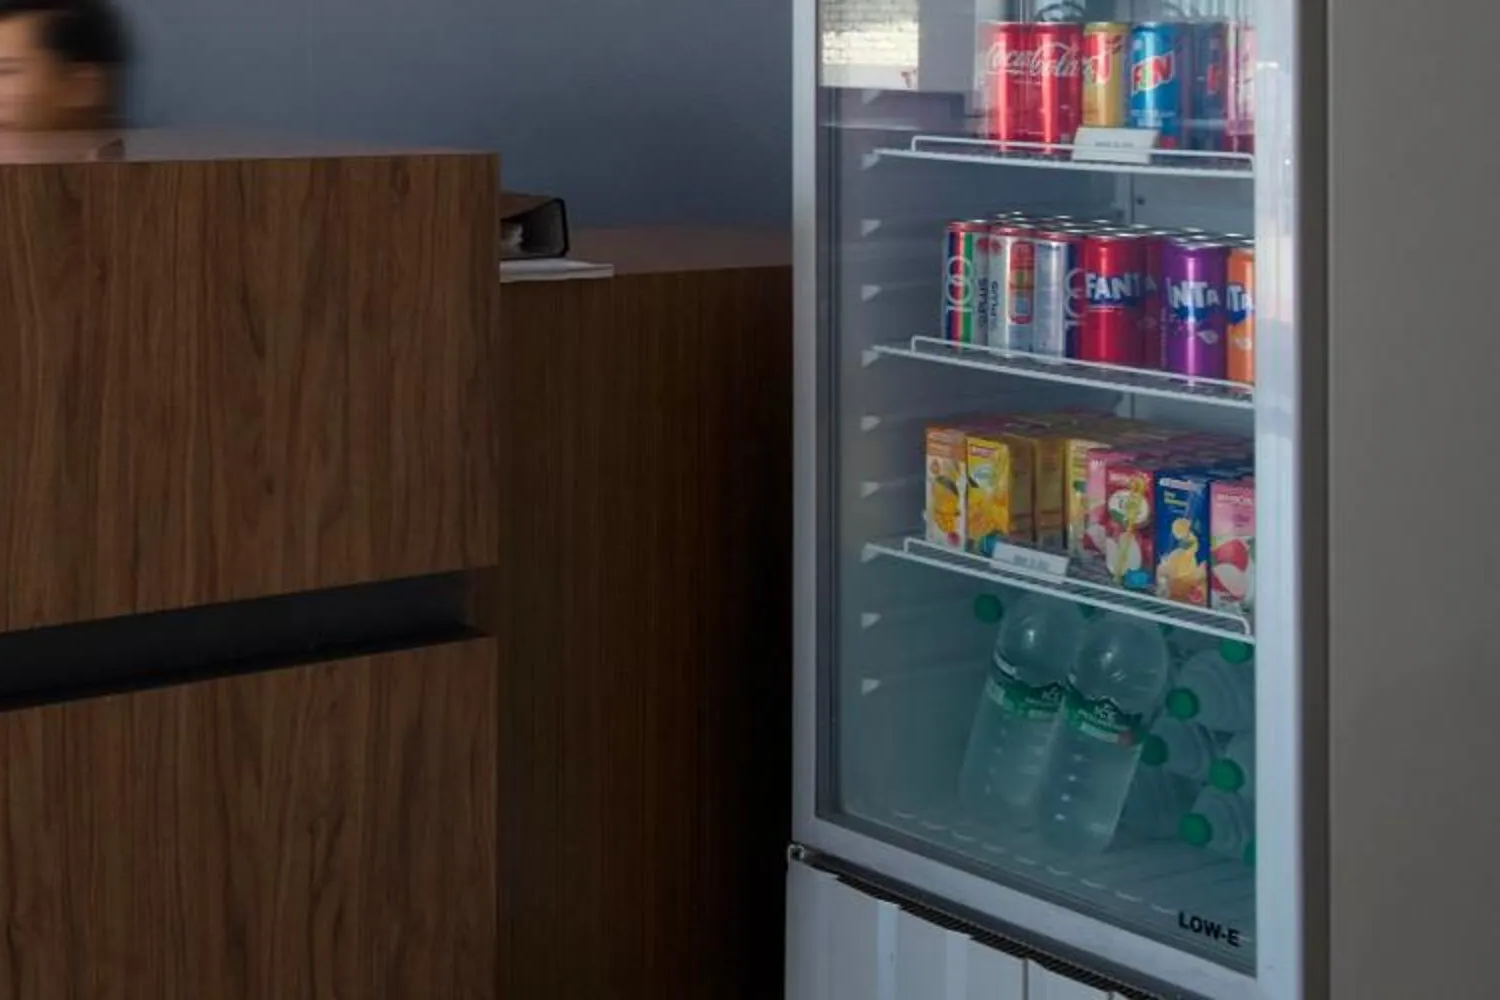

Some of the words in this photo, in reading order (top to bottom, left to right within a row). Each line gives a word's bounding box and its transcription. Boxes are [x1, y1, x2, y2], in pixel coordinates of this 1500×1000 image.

[946, 255, 975, 313] 100
[1085, 271, 1157, 301] FANTA
[1166, 278, 1220, 309] NTA
[1178, 910, 1242, 948] LOW-E
